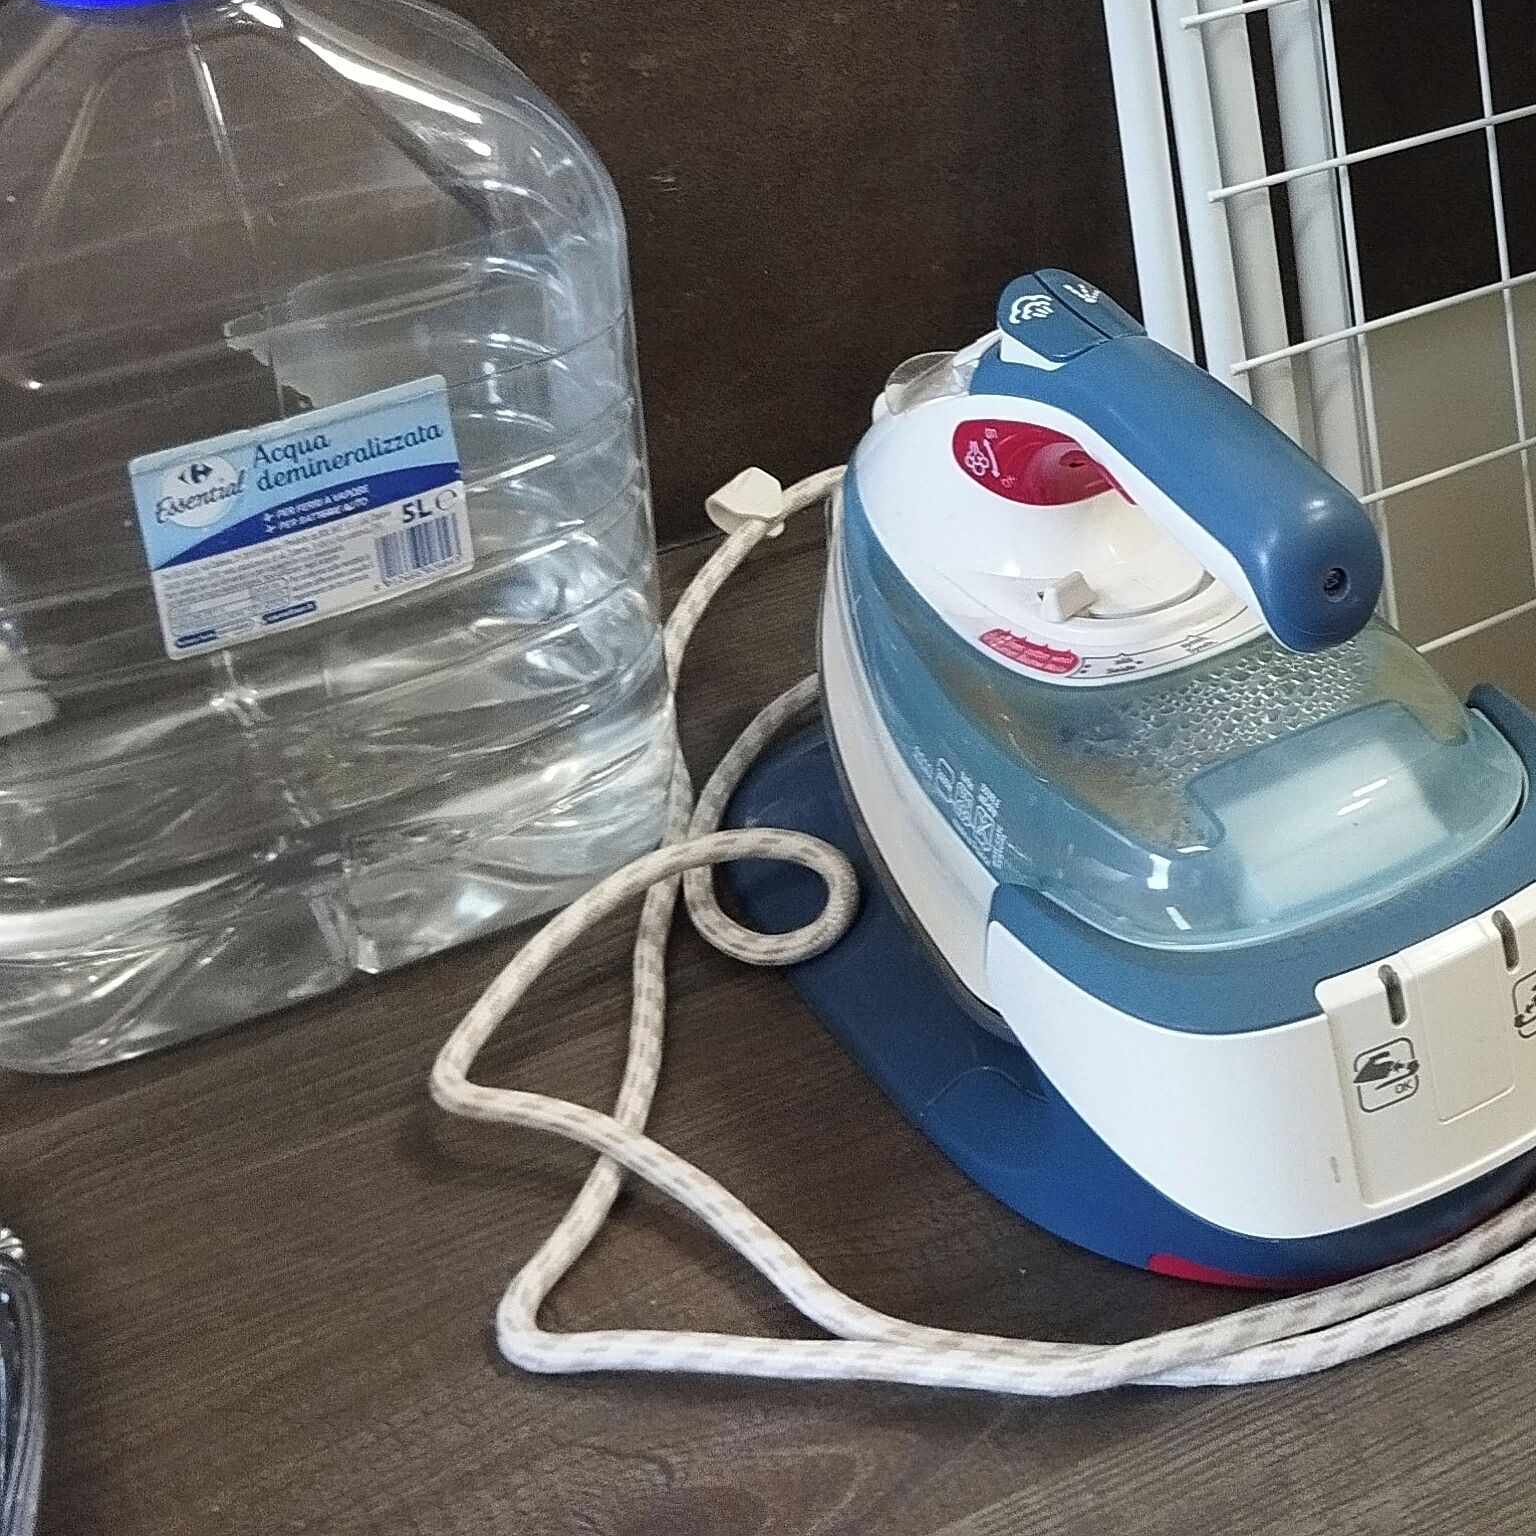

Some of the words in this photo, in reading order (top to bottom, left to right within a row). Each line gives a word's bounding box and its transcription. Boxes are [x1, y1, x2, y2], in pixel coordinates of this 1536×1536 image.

[254, 434, 330, 467] Acqua
[256, 423, 443, 491] demineralizzata
[155, 469, 246, 525] Essential
[402, 498, 433, 524] 5L
[1394, 1080, 1414, 1095] OK
